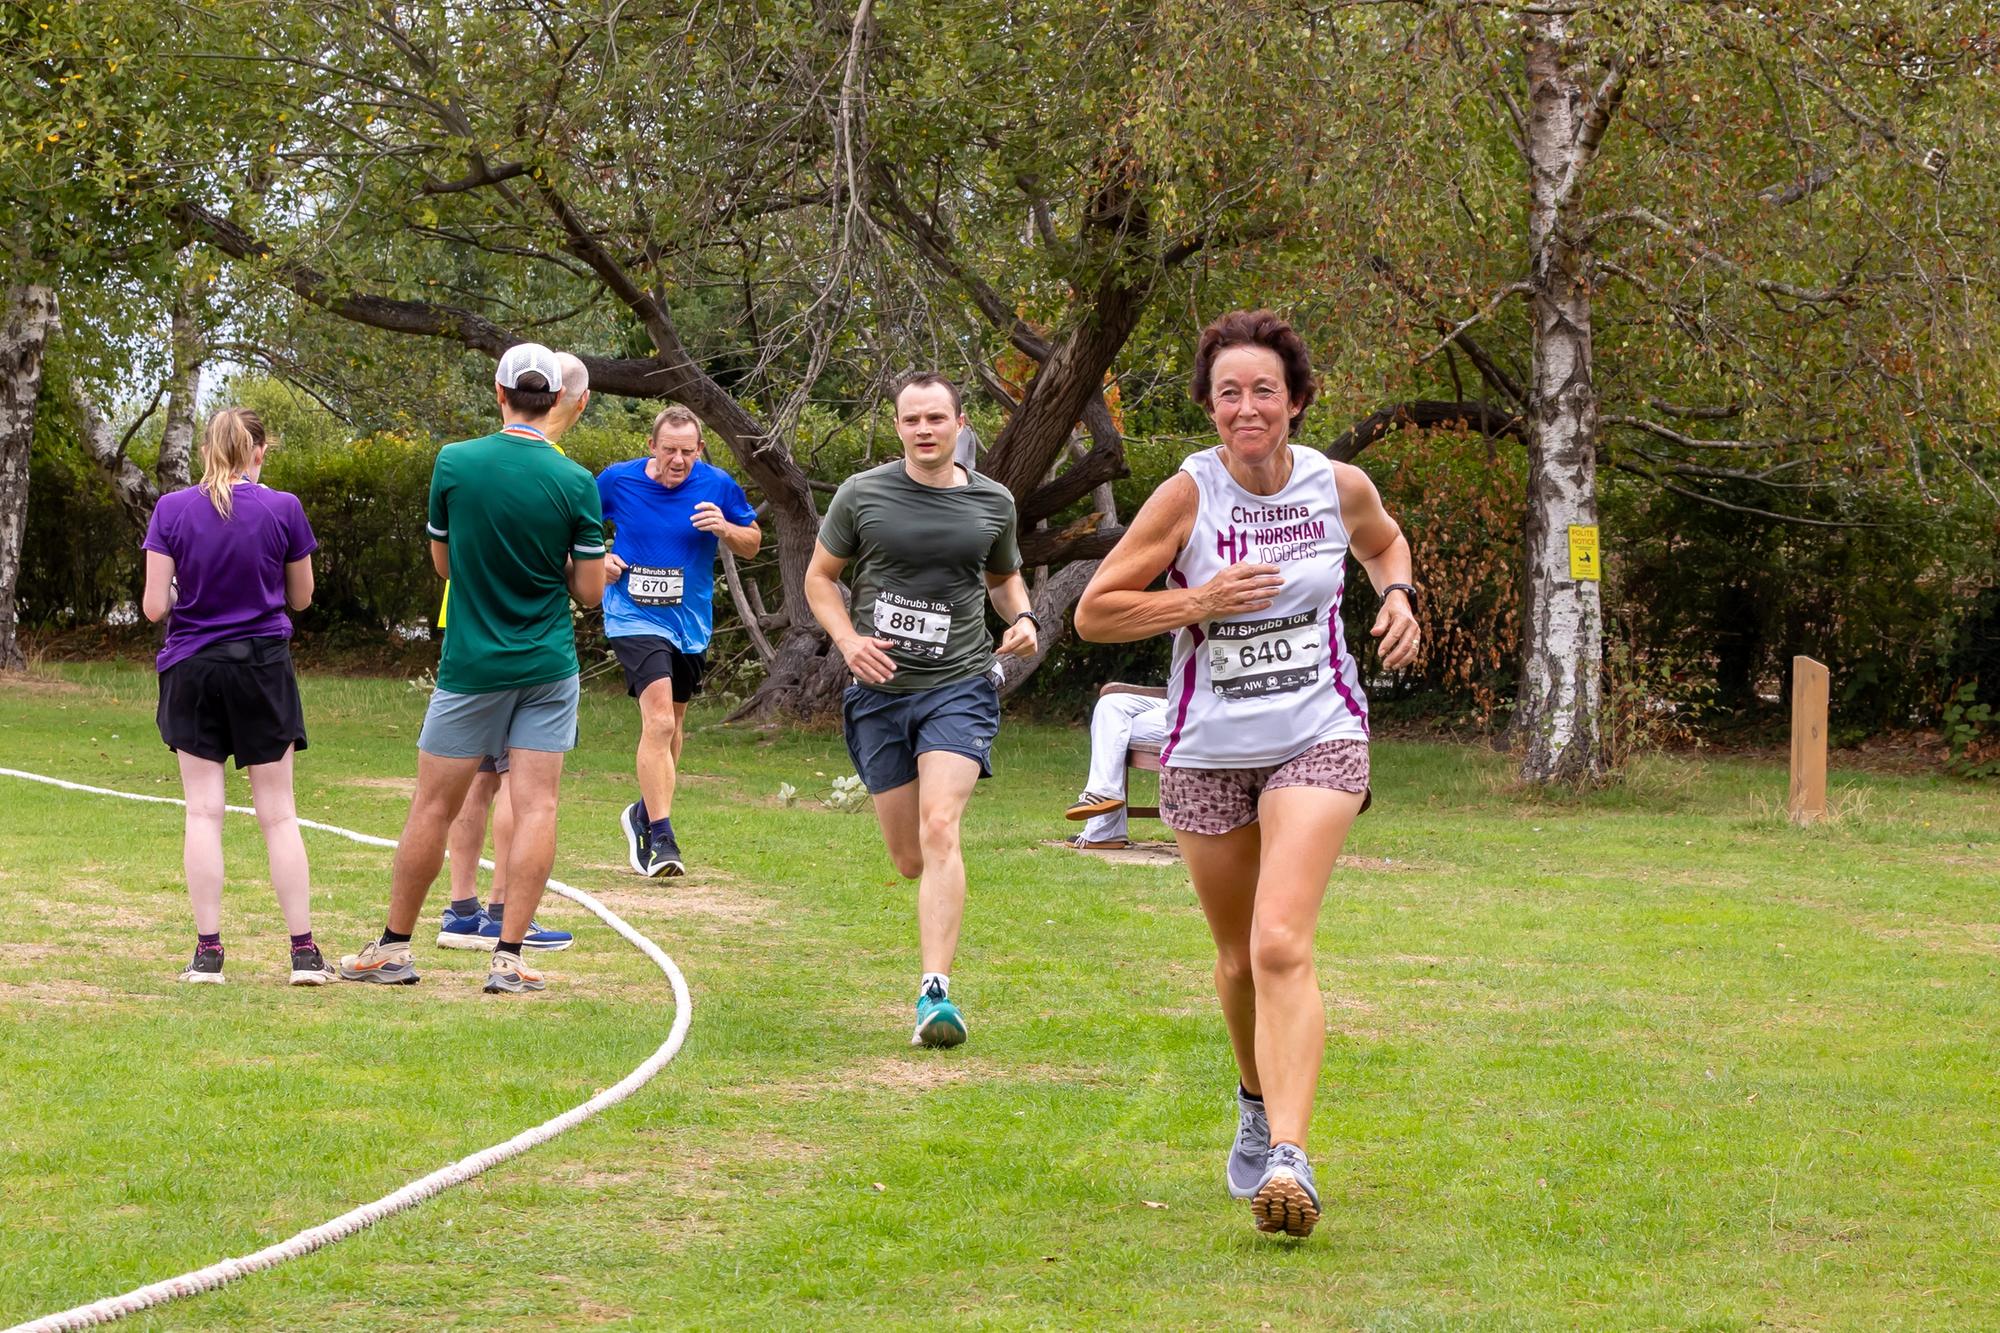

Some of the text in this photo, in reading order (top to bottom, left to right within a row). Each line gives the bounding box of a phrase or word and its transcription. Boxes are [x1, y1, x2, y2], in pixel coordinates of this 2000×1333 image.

[1231, 505, 1309, 523] Christina
[1255, 521, 1325, 545] HORSHAM
[1259, 541, 1317, 564] JOGGERS
[642, 568, 666, 576] Shrubb
[642, 580, 668, 593] 670
[881, 591, 894, 601] Alf
[894, 595, 928, 609] Shrubb
[890, 612, 926, 634] 881
[1216, 626, 1236, 636] Alf
[1238, 619, 1283, 636] Shrubb
[1239, 639, 1292, 668] 640
